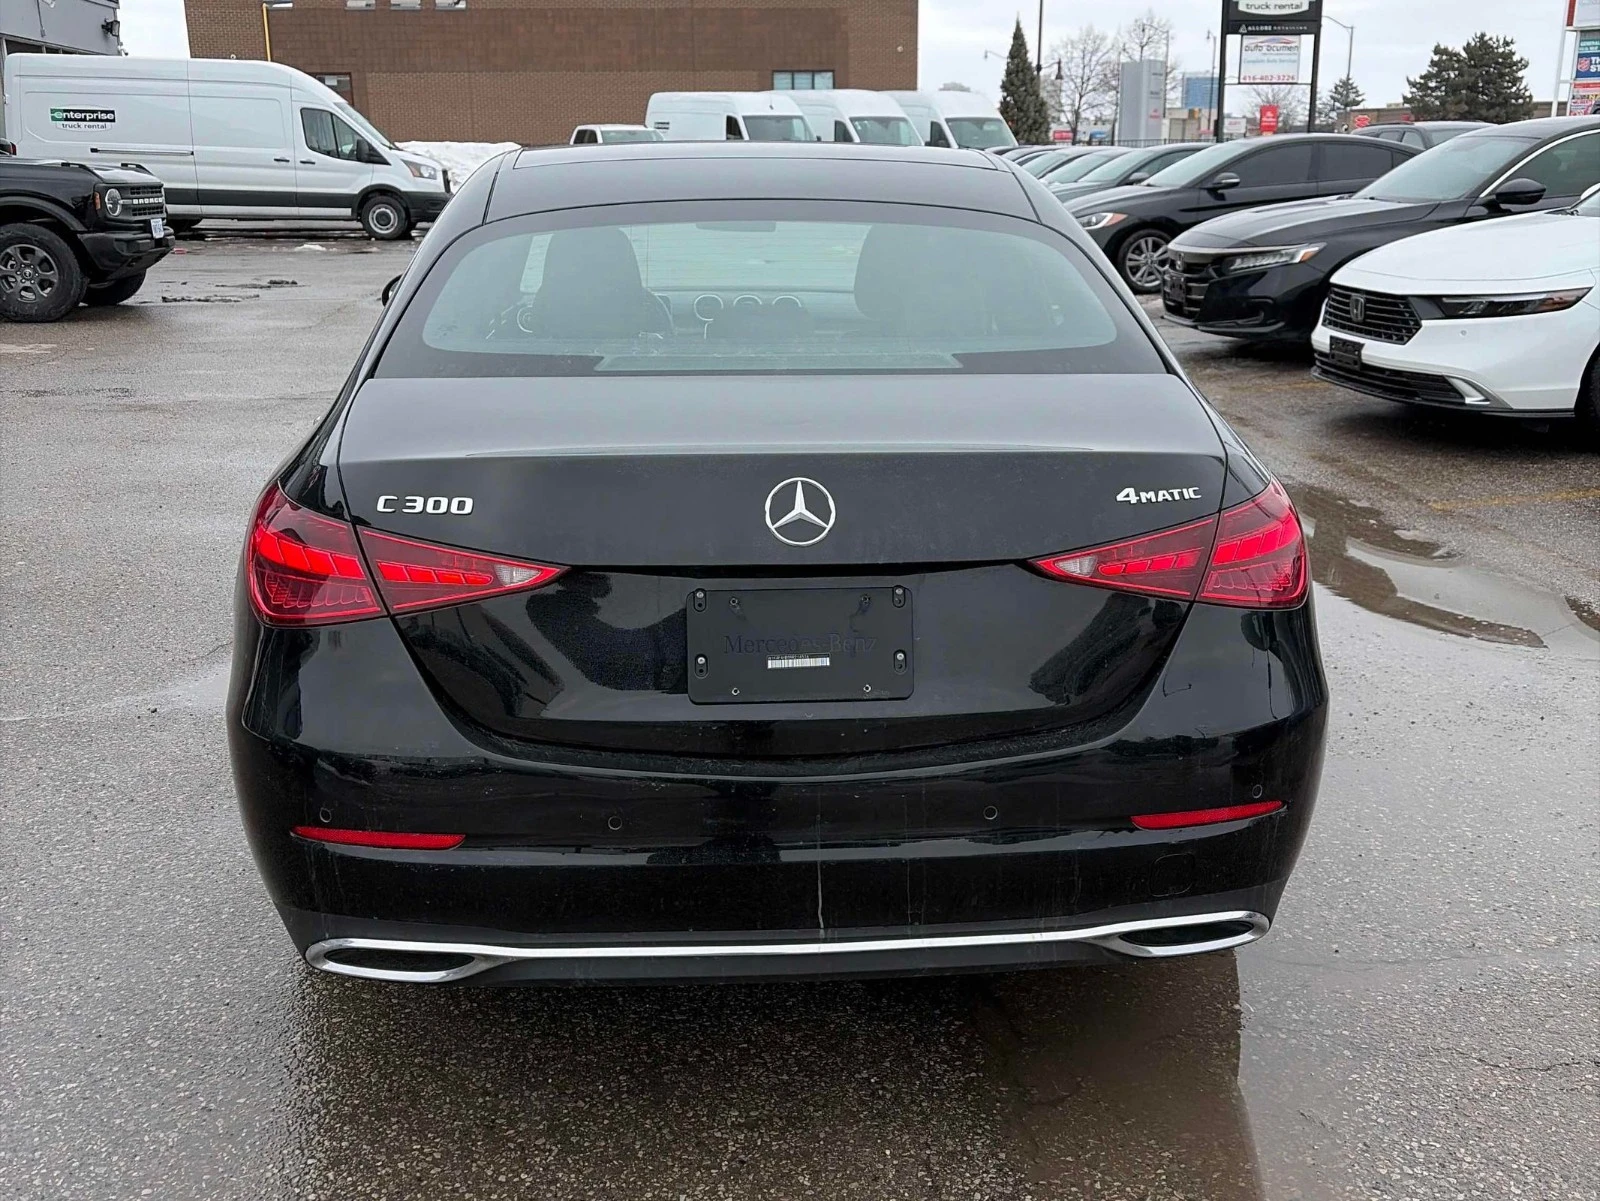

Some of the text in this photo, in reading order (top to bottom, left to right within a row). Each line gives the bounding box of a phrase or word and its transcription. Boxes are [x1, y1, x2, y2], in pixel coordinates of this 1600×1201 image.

[1246, 2, 1303, 10] truck rental
[51, 111, 115, 121] enterprise
[1116, 487, 1202, 504] 4MATIC
[376, 495, 474, 515] C 300
